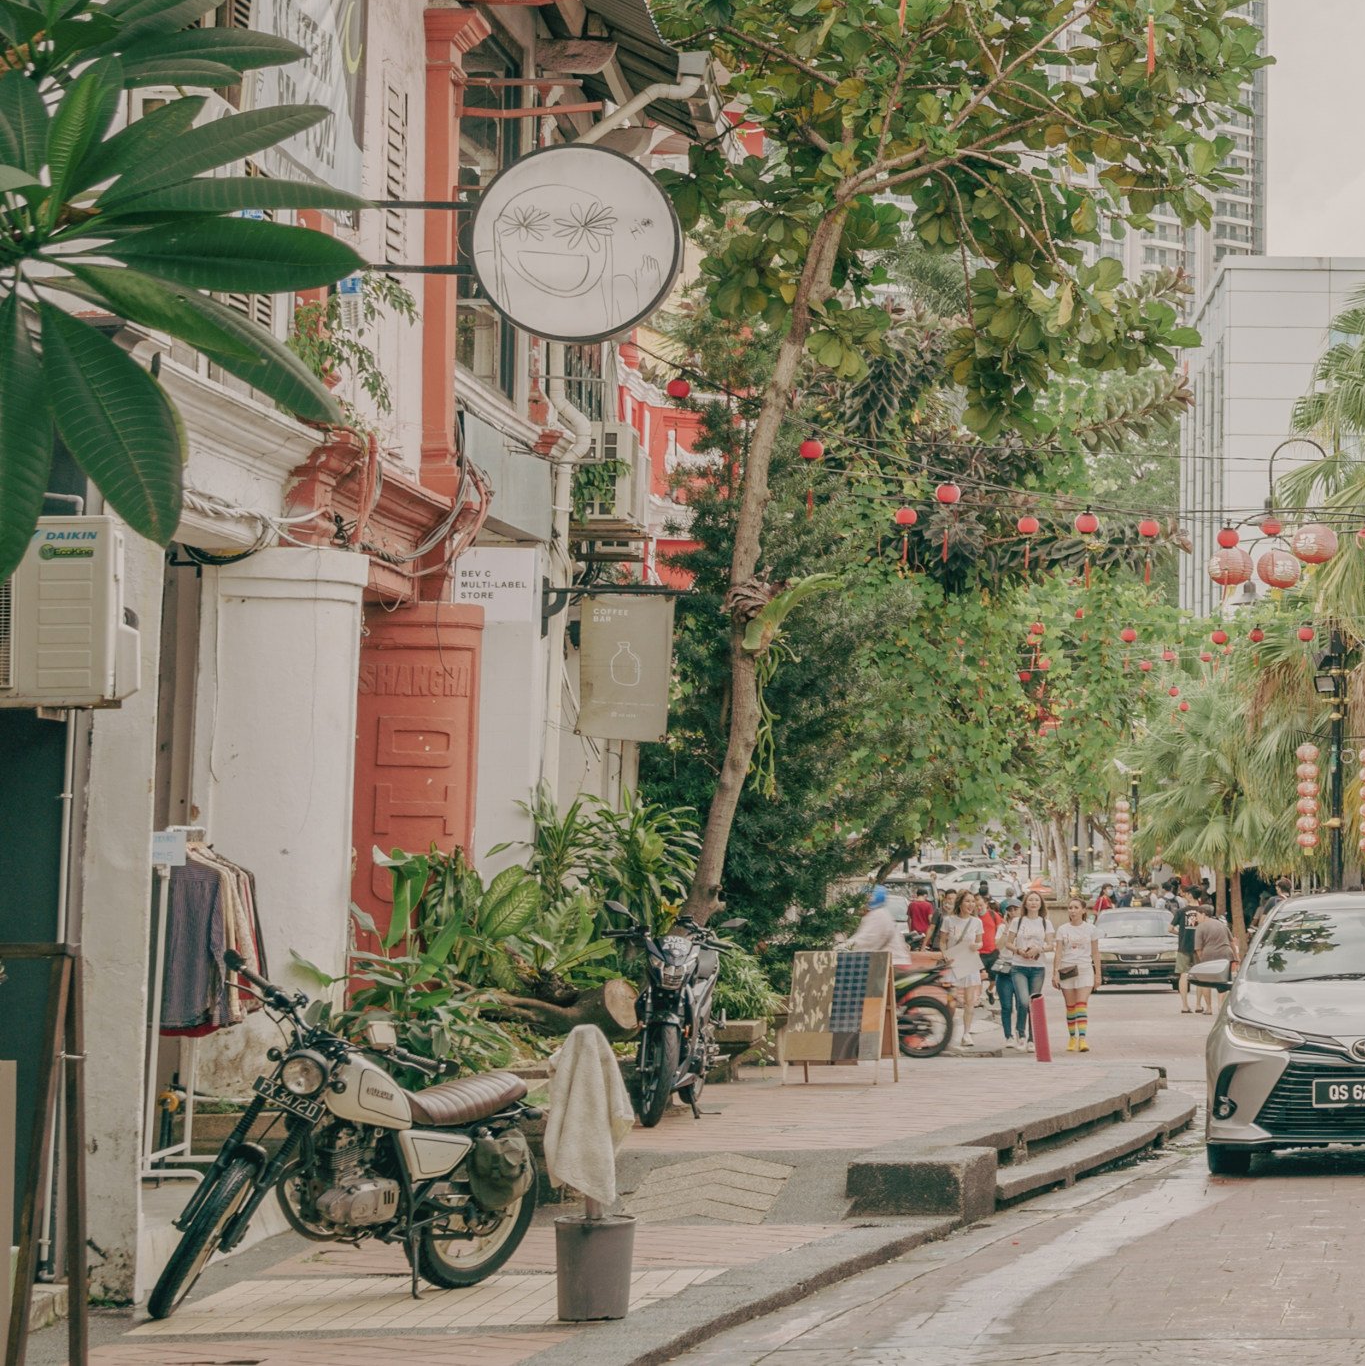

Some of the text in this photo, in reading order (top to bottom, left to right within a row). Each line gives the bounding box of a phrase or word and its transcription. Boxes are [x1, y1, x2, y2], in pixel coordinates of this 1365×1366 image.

[46, 531, 97, 540] DAIKIN
[461, 591, 494, 599] STORE
[593, 608, 629, 616] COFFEE
[1328, 1085, 1349, 1101] QS
